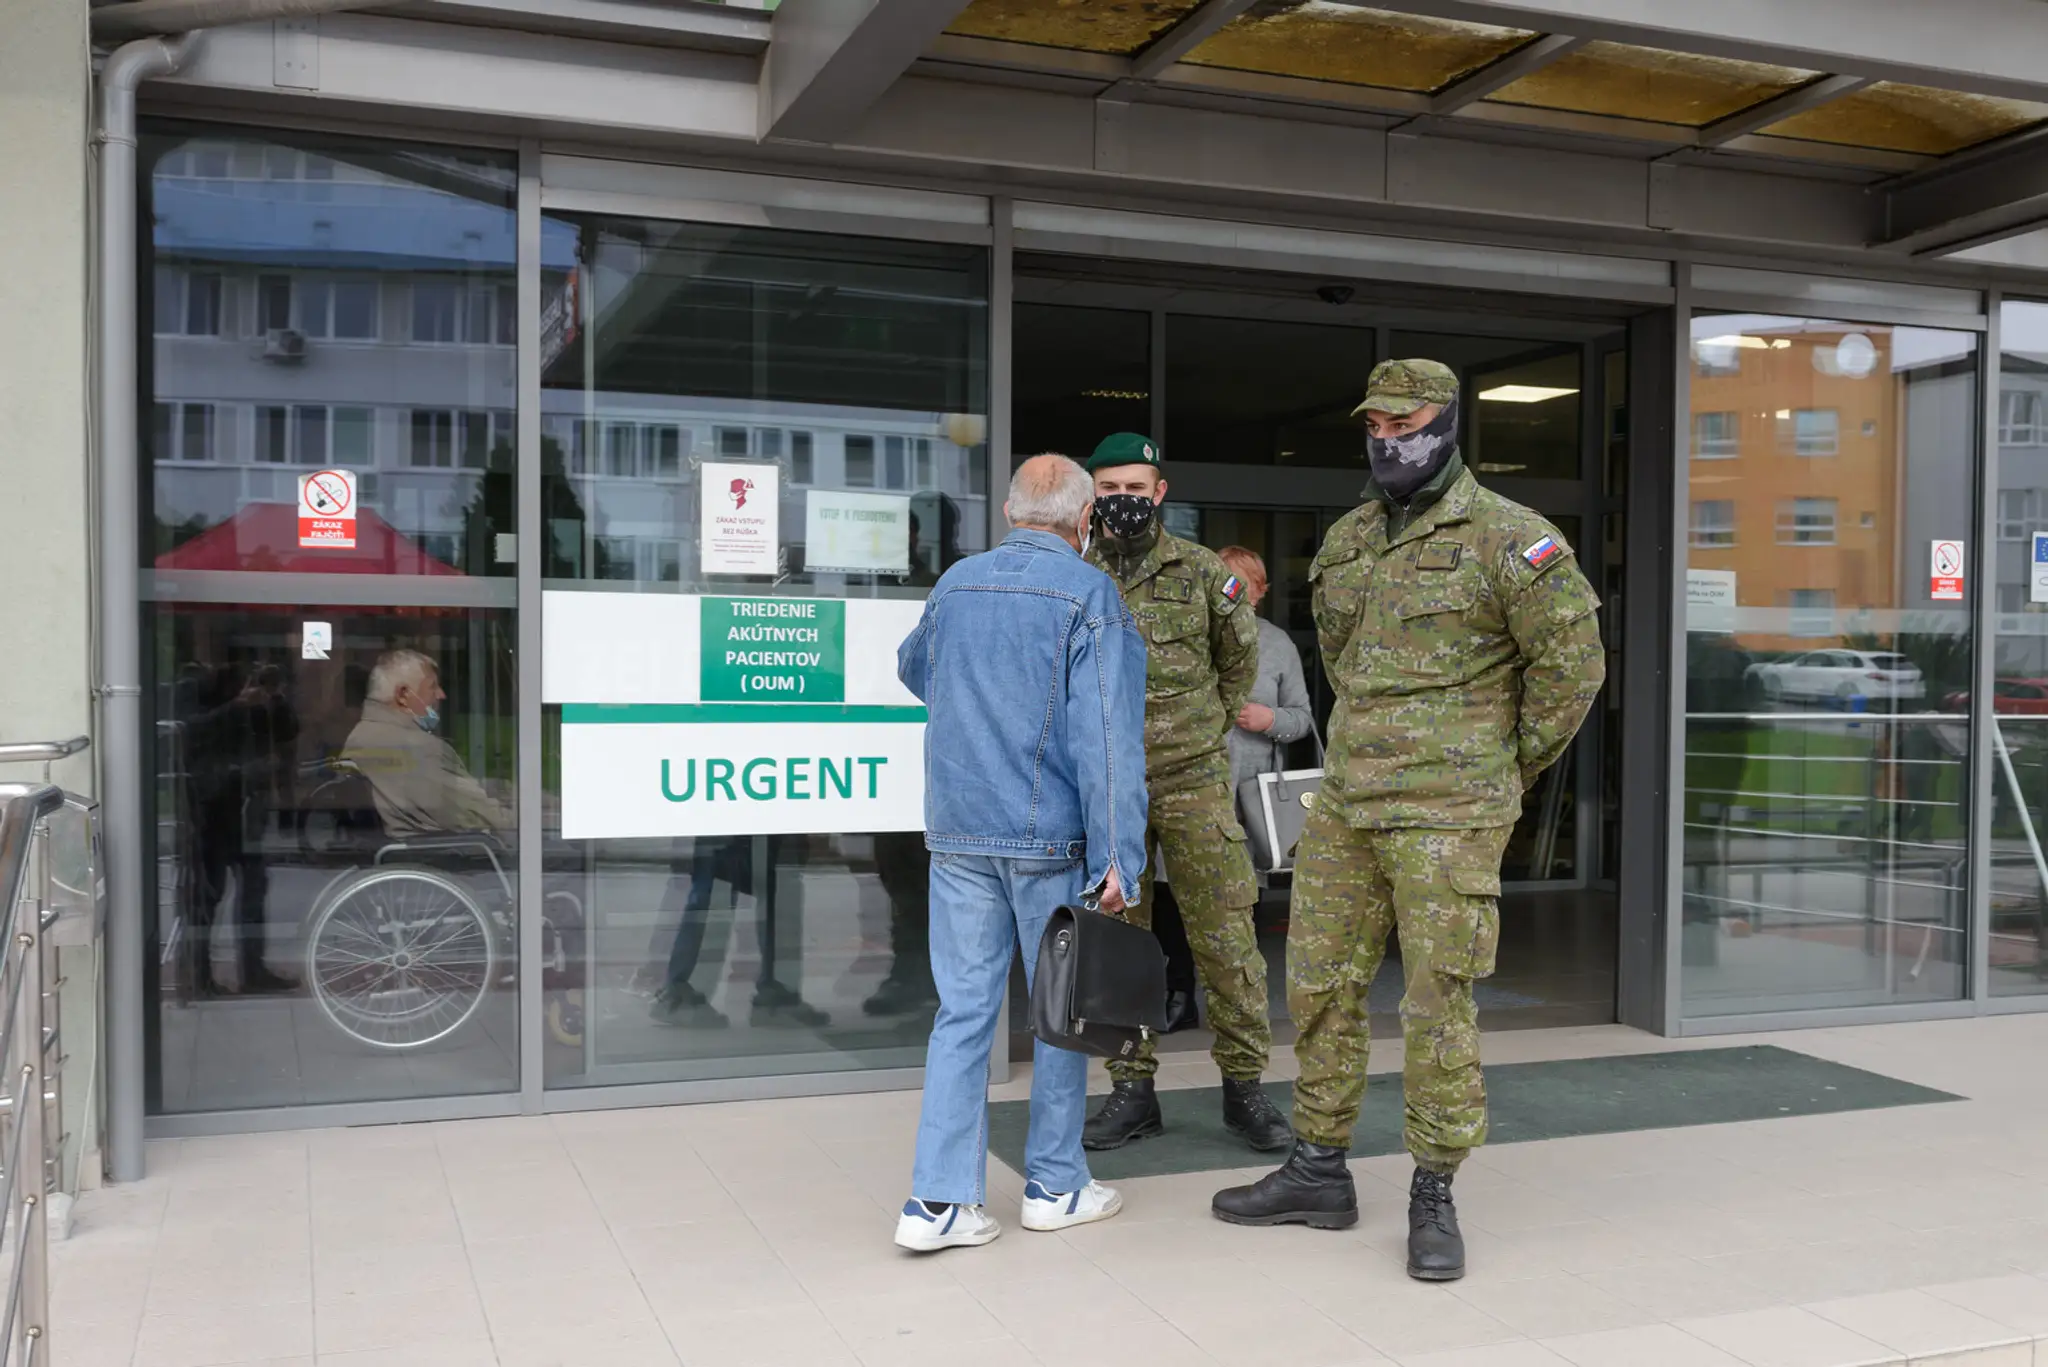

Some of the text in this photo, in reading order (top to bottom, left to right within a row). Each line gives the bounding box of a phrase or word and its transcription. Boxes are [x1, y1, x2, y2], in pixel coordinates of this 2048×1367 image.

[730, 601, 816, 618] TRIEDENIE
[727, 623, 818, 643] AKÚTNYCH
[725, 650, 821, 667] PACIENTOV
[661, 757, 888, 803] URGENT
